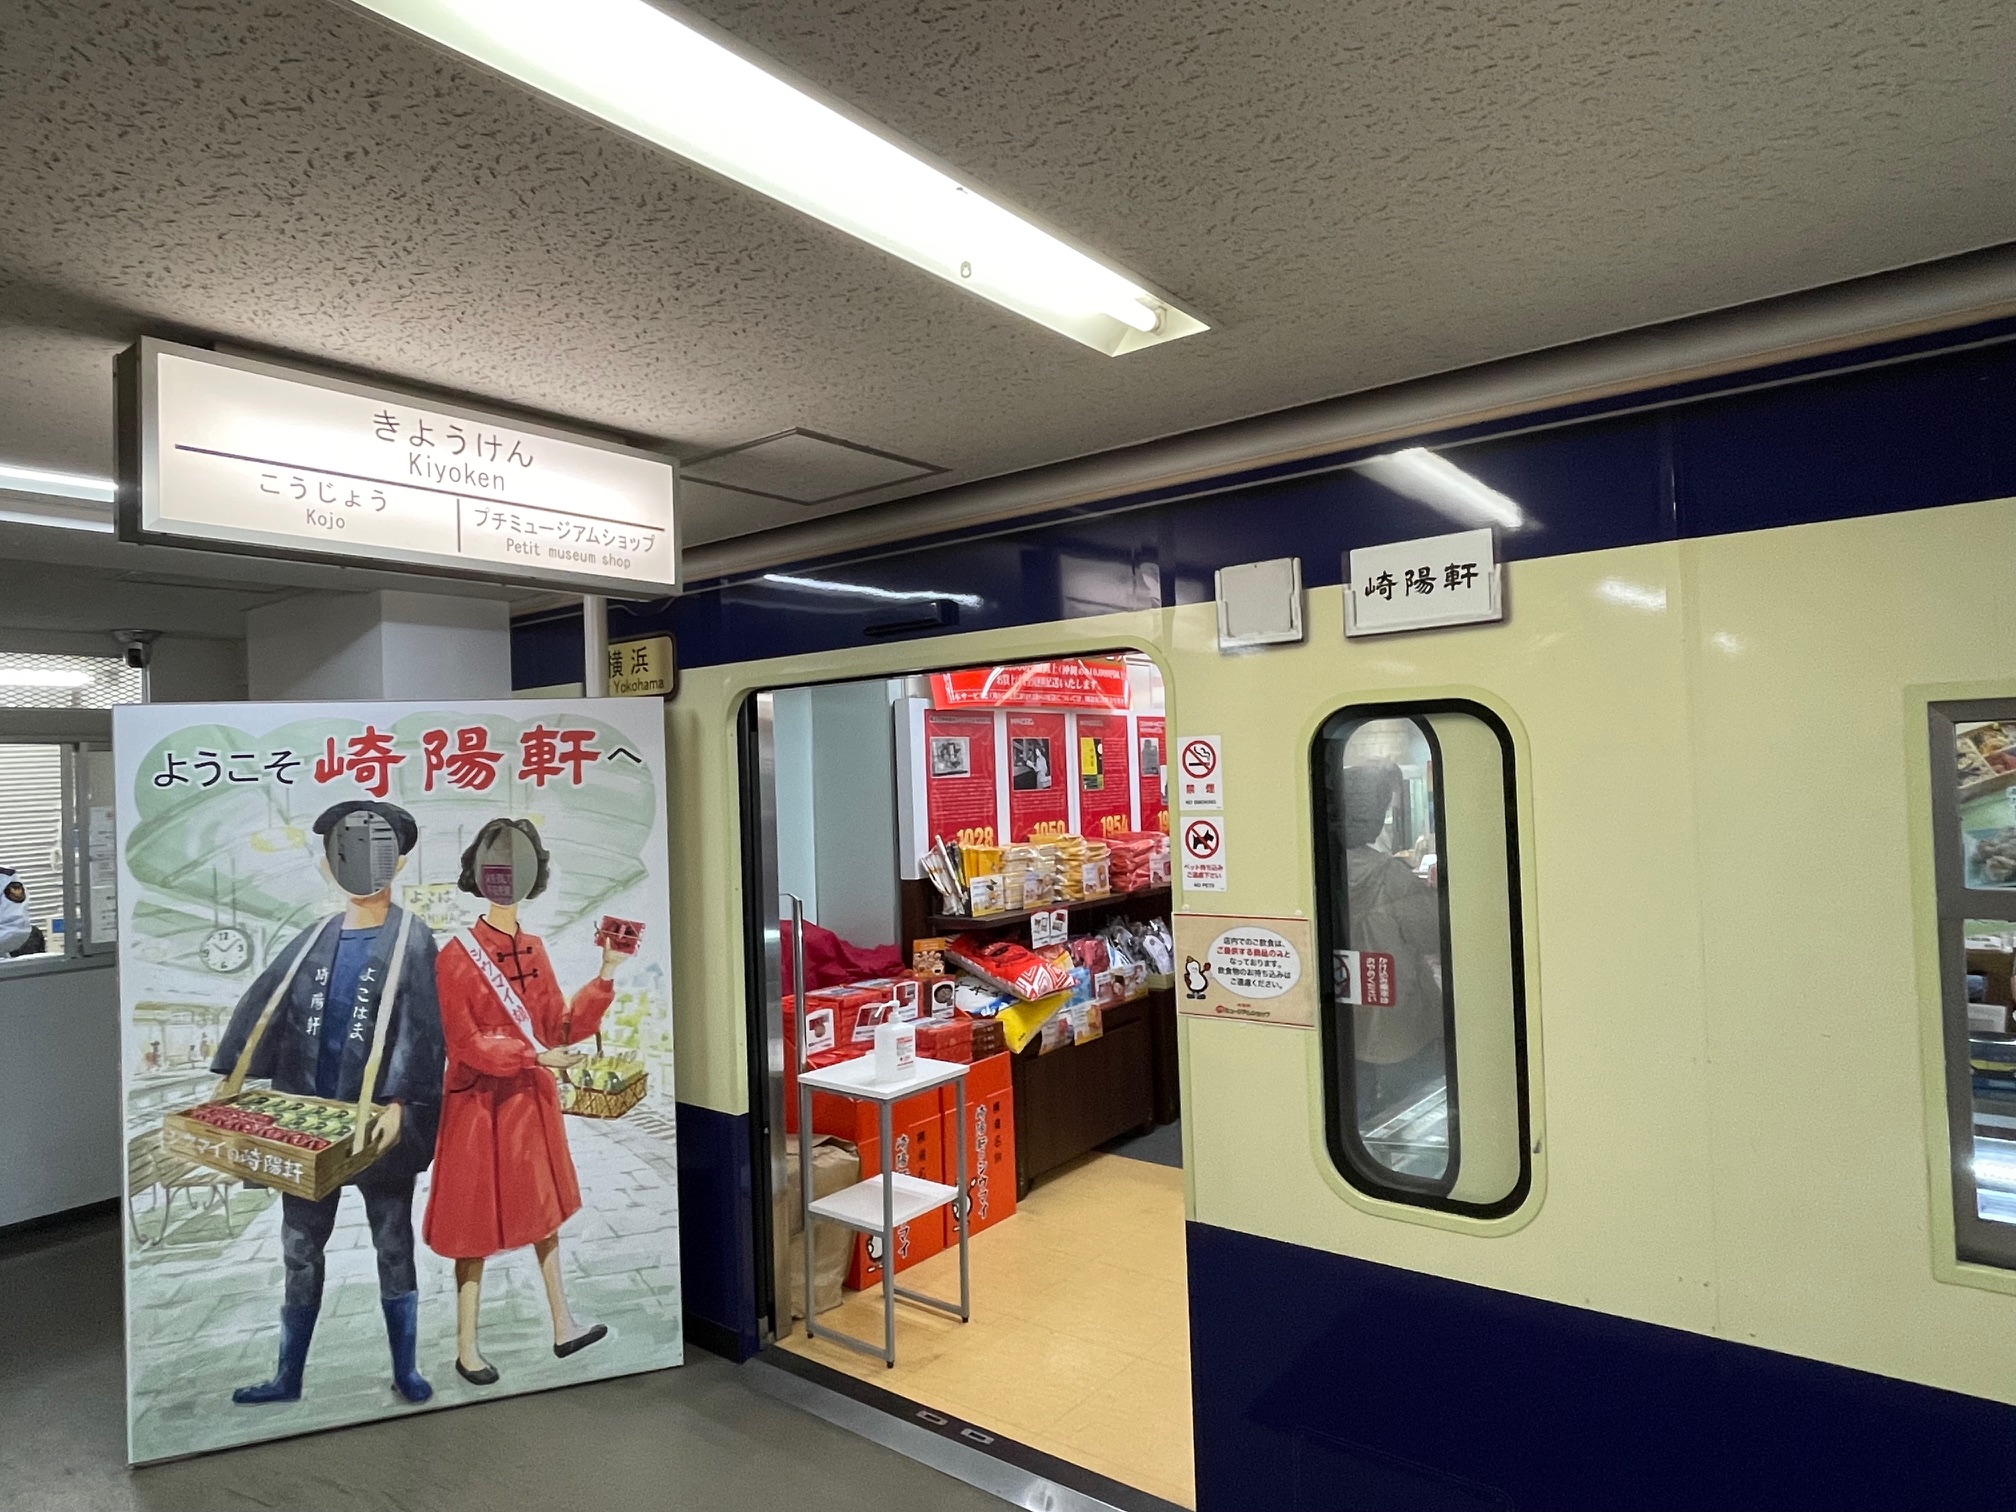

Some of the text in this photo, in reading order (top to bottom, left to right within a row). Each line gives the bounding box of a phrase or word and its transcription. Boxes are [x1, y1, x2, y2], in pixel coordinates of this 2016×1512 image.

[409, 452, 505, 491] Kiyoken
[261, 473, 386, 511] こうじょう
[306, 508, 345, 529] Kojo
[475, 507, 656, 552] プチミュージアムショップ
[506, 538, 631, 570] Petit museum shop
[1365, 562, 1479, 601] 崎陽軒
[608, 646, 649, 678] 横浜
[613, 678, 664, 693] Yokohama
[1100, 814, 1129, 838] 1954
[350, 967, 377, 1042] よこはま
